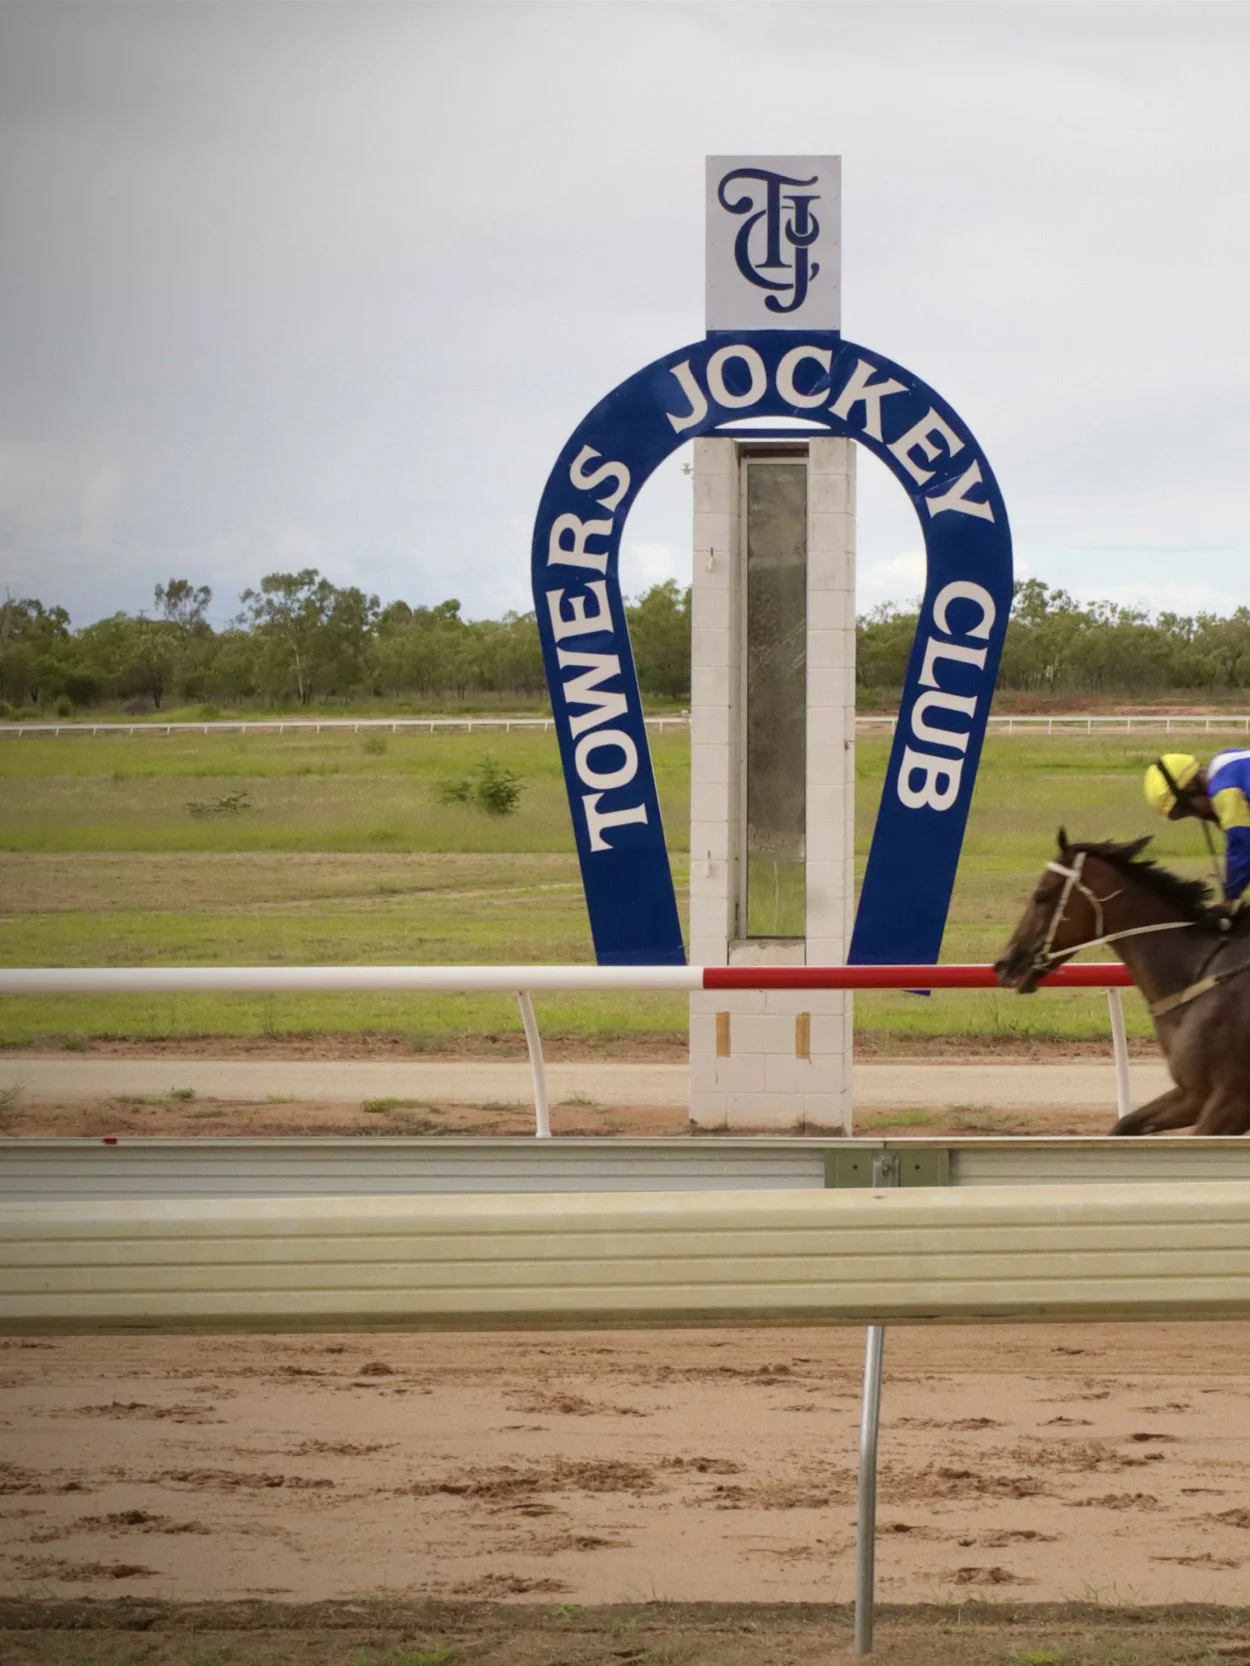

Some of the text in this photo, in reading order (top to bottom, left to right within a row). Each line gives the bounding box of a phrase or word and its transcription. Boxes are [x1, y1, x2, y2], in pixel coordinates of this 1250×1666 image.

[546, 343, 996, 852] TOWERS JOCKEY CLUB
